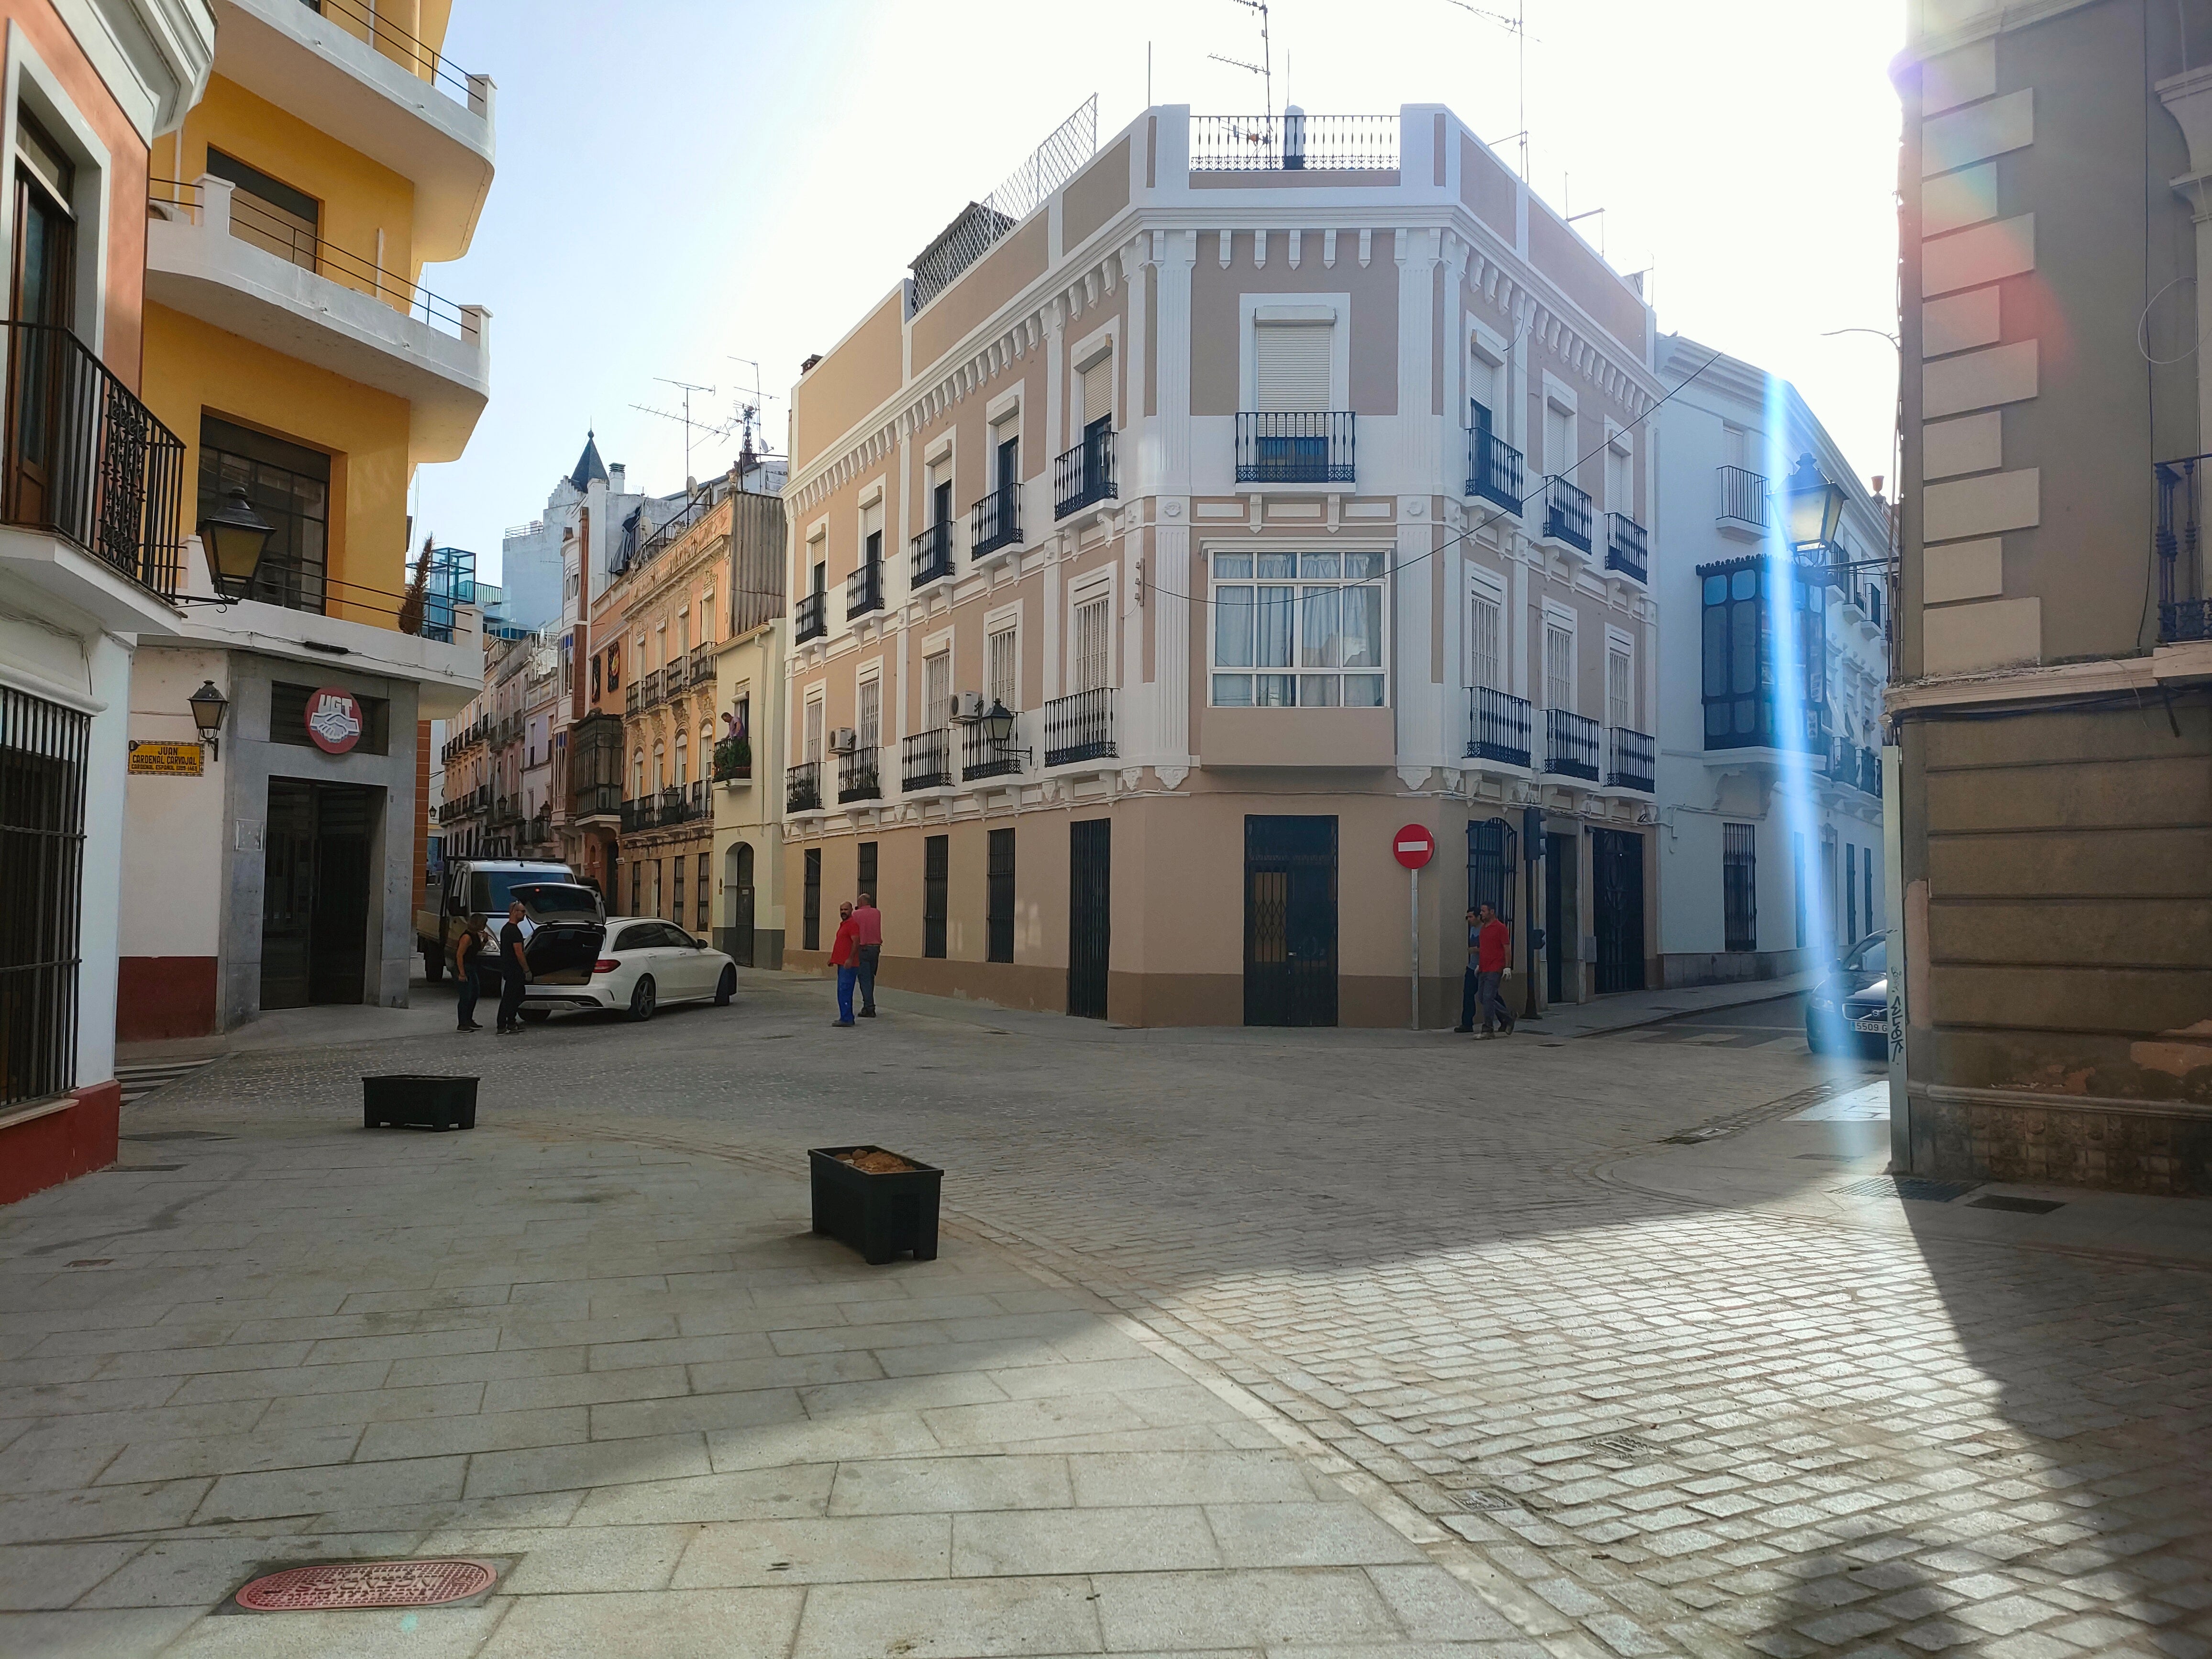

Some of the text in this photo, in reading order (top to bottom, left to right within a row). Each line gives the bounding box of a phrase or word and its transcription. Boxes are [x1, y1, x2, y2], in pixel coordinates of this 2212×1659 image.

[318, 694, 352, 718] UGT
[158, 747, 177, 755] JUAN
[133, 755, 197, 765] CARDENAL CARVAJAL
[1857, 1022, 1879, 1031] 5509
